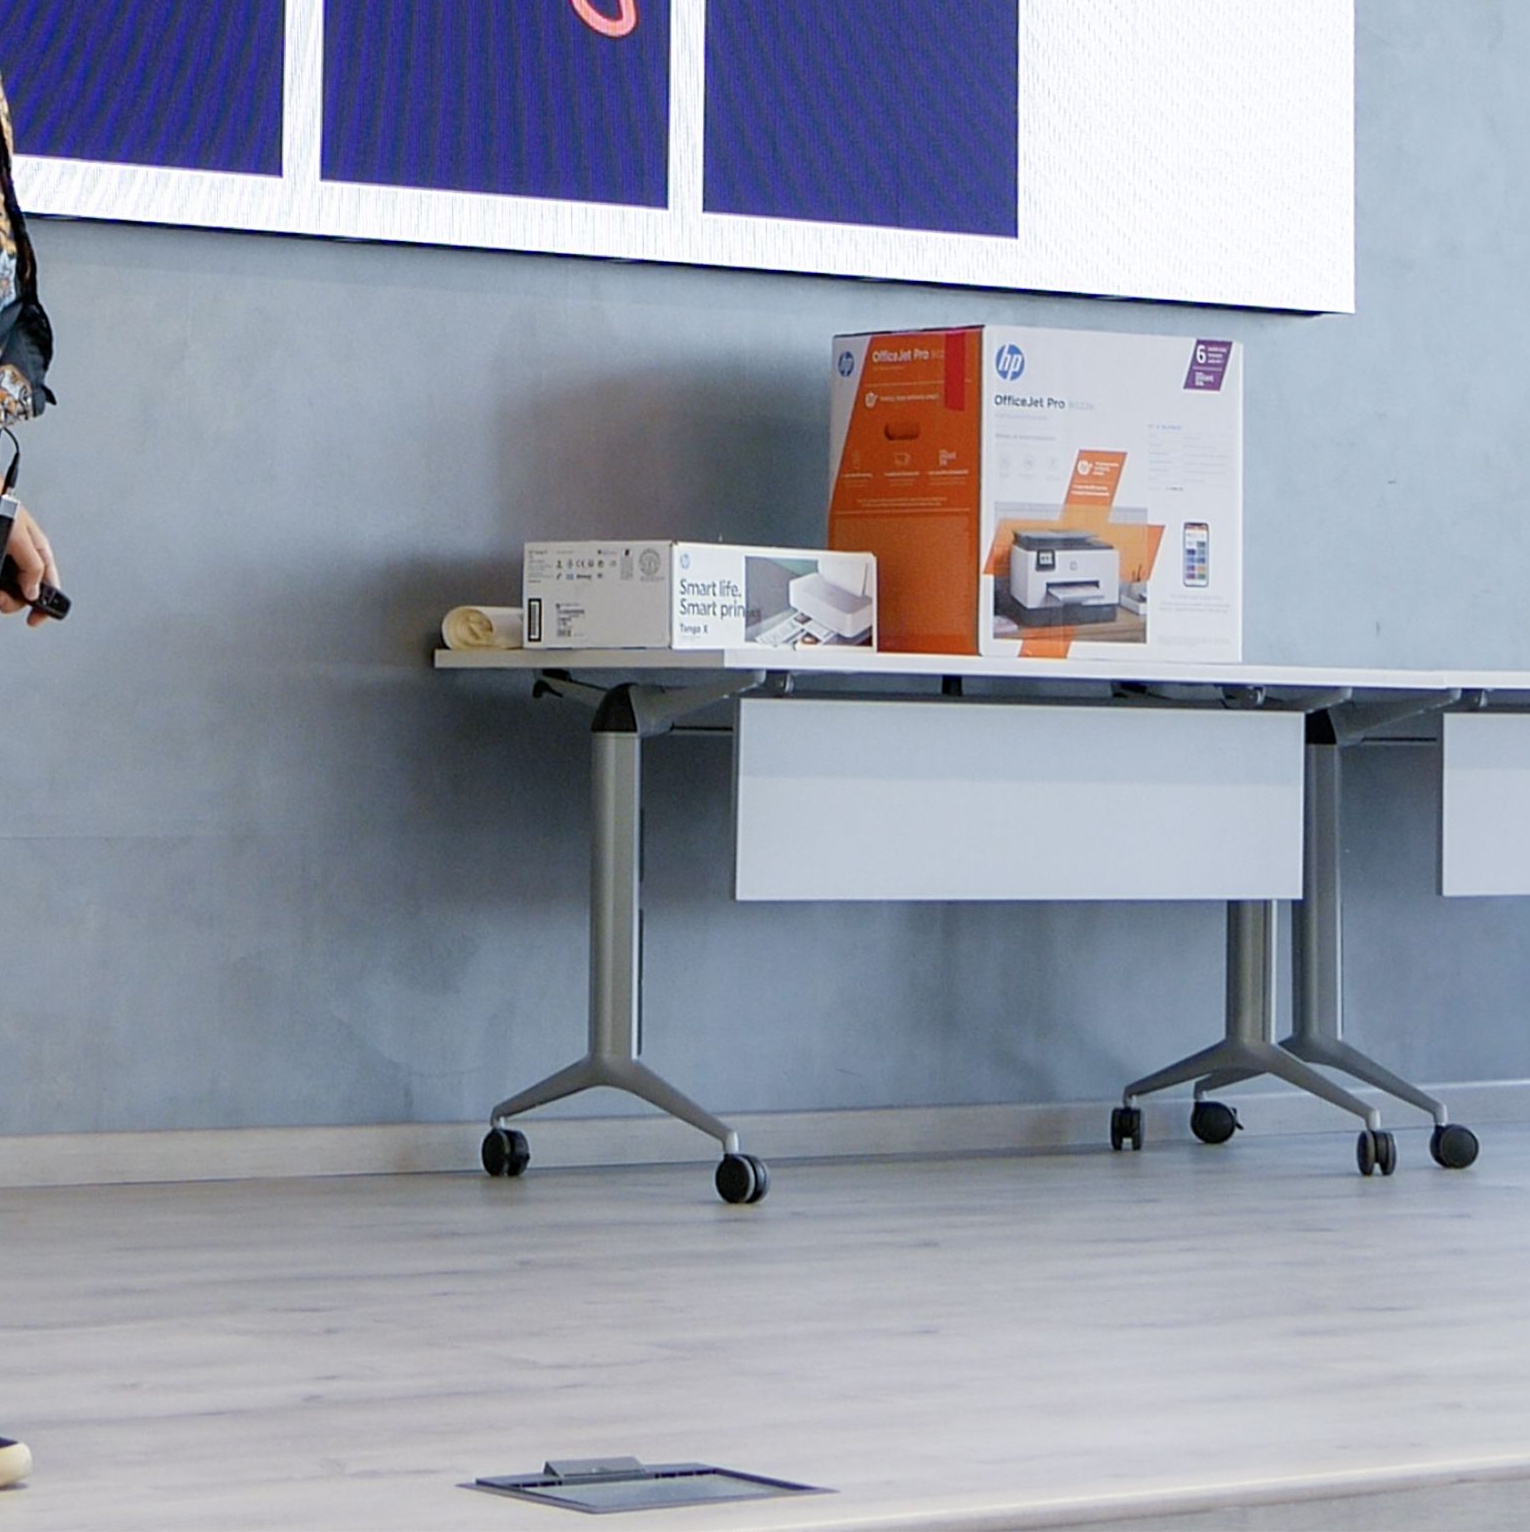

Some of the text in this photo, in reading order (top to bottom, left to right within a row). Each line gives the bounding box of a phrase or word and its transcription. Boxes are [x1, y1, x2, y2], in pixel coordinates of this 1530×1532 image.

[871, 349, 912, 363] OfficeJet
[913, 347, 930, 361] Pro
[995, 344, 1025, 381] hp
[1196, 344, 1207, 364] 6
[994, 394, 1044, 409] OfficeJet
[1046, 396, 1066, 410] Pro
[679, 578, 742, 598] Smart life.
[679, 597, 717, 617] Smart
